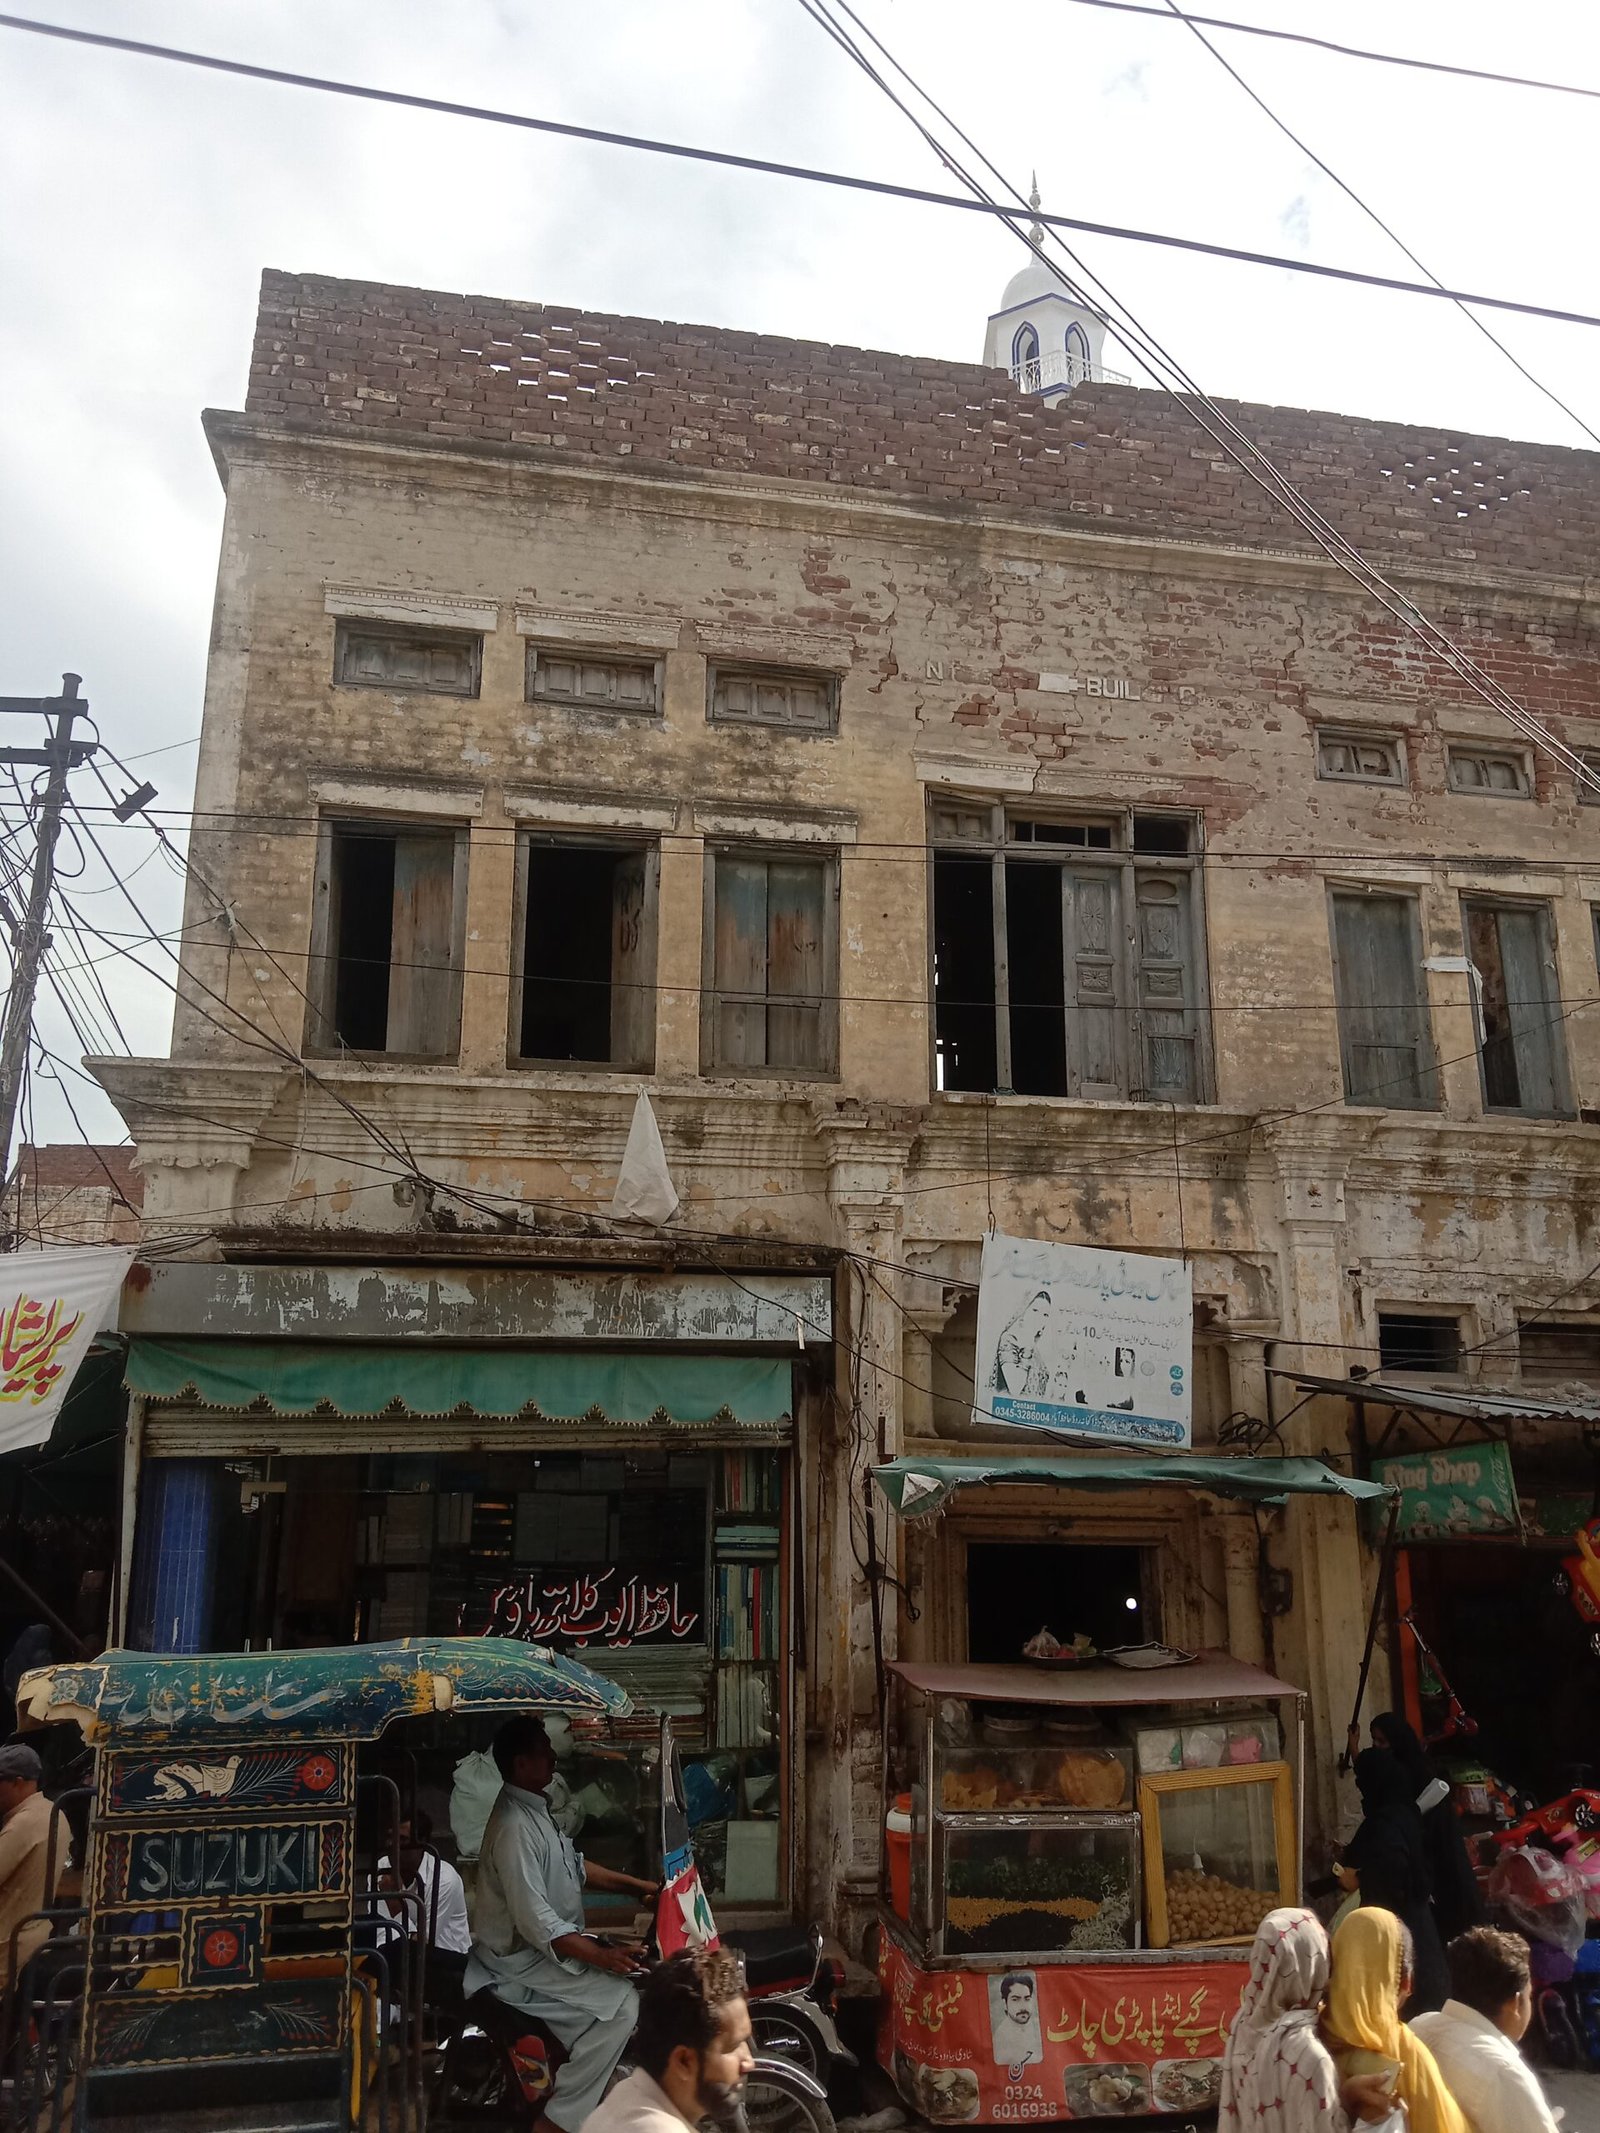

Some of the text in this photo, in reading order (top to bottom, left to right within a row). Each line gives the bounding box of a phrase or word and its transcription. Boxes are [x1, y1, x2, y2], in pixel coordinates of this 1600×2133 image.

[1083, 1326, 1096, 1338] 10
[994, 1405, 1050, 1423] 0345-3286004
[1012, 1400, 1037, 1411] Contact
[1430, 1455, 1482, 1487] Shop
[635, 1581, 699, 1637] حافظ
[139, 1829, 319, 1893] SUZUKI
[1046, 1997, 1100, 2059] چاٹ
[1005, 2085, 1043, 2101] 0324
[992, 2101, 1058, 2119] 6016938
